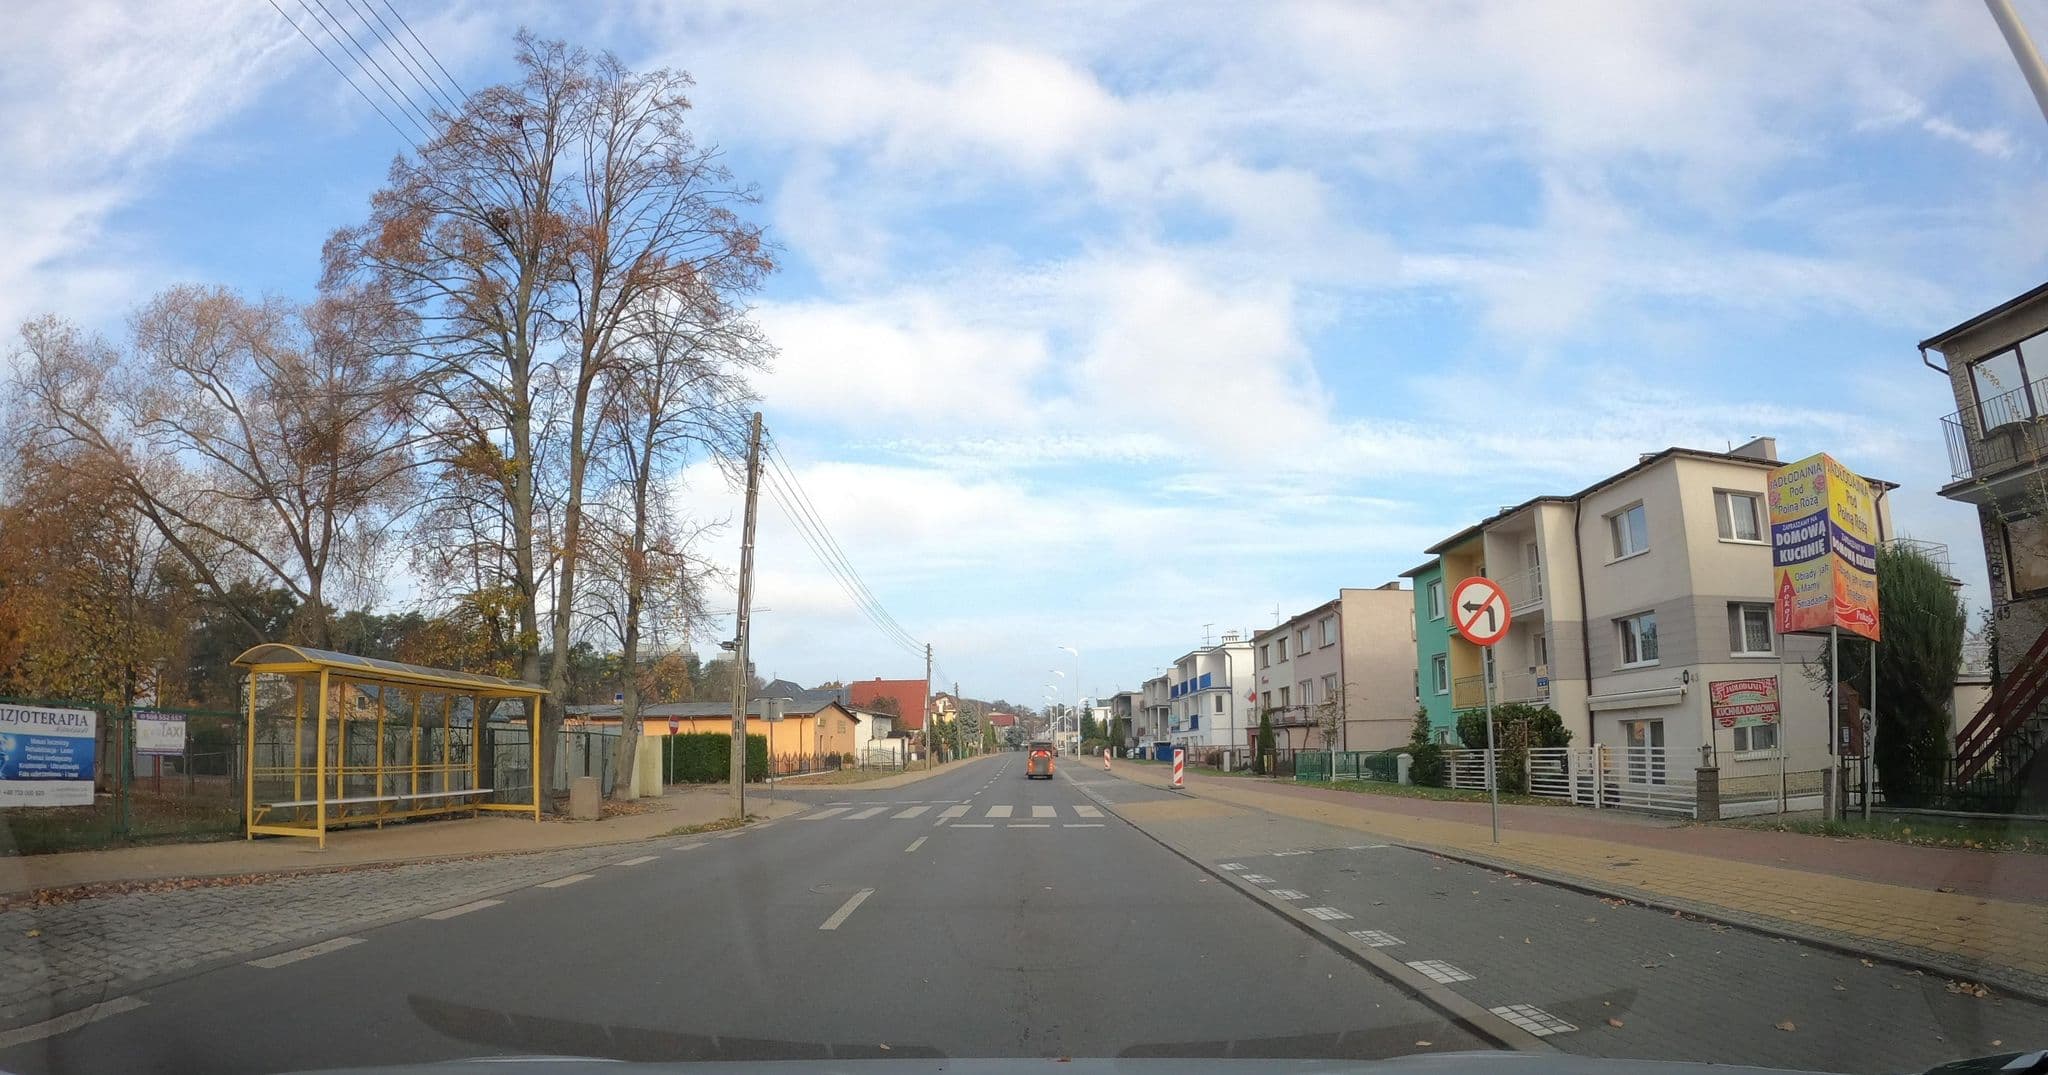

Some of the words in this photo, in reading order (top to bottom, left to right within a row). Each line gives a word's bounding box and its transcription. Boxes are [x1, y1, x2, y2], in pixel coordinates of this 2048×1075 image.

[1790, 484, 1803, 497] Pod
[1776, 519, 1826, 546] DOMOWĄ
[1780, 538, 1825, 562] KUCHNIĘ
[0, 709, 88, 727] IZJOTERAPIA
[1716, 706, 1745, 717] KUCHNIA
